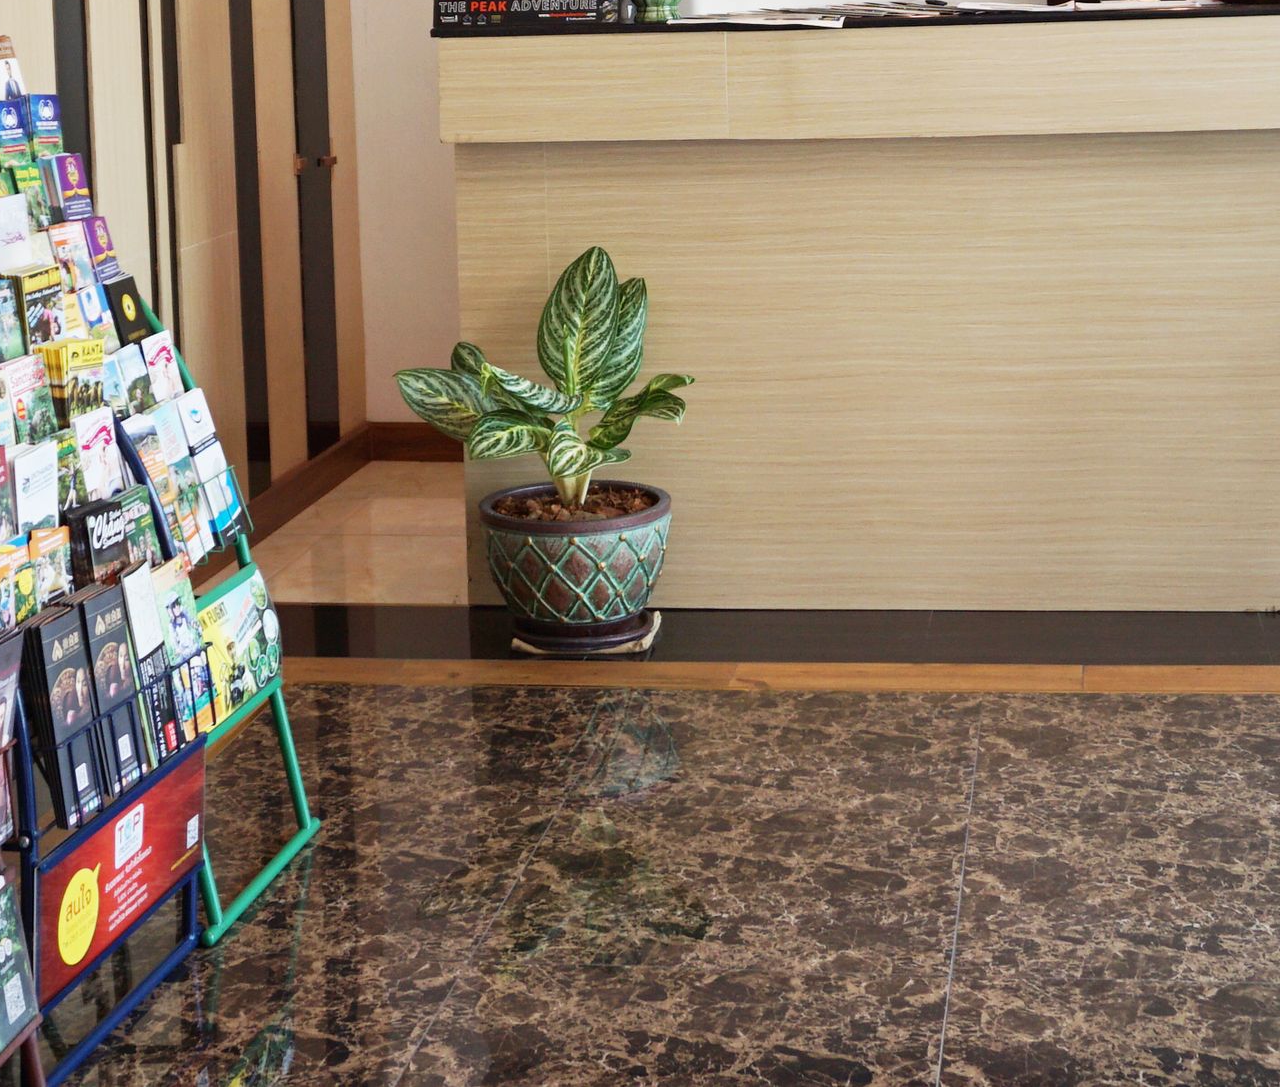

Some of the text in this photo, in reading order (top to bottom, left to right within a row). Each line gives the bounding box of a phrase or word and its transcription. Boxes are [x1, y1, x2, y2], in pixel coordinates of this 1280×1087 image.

[438, 1, 466, 14] THE
[470, 0, 507, 13] PEAK
[65, 883, 92, 922] สนใจ
